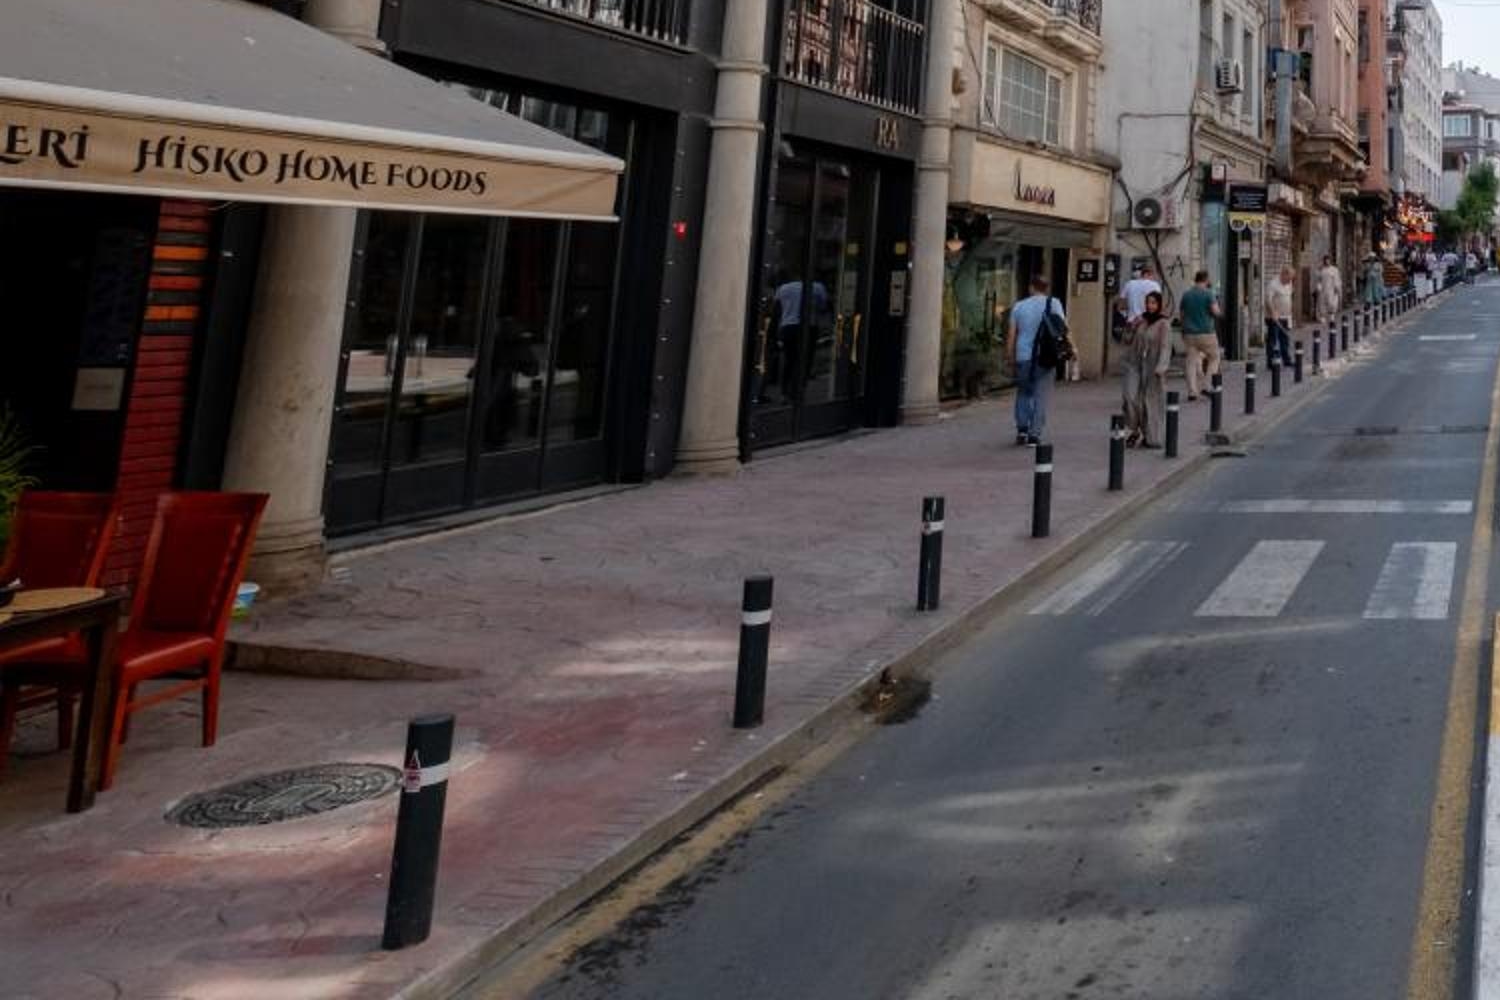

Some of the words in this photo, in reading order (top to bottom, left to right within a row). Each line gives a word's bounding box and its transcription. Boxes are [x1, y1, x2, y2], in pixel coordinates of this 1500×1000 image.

[0, 124, 90, 168] ERİ
[274, 150, 377, 190] HOME
[386, 163, 488, 195] FOODS
